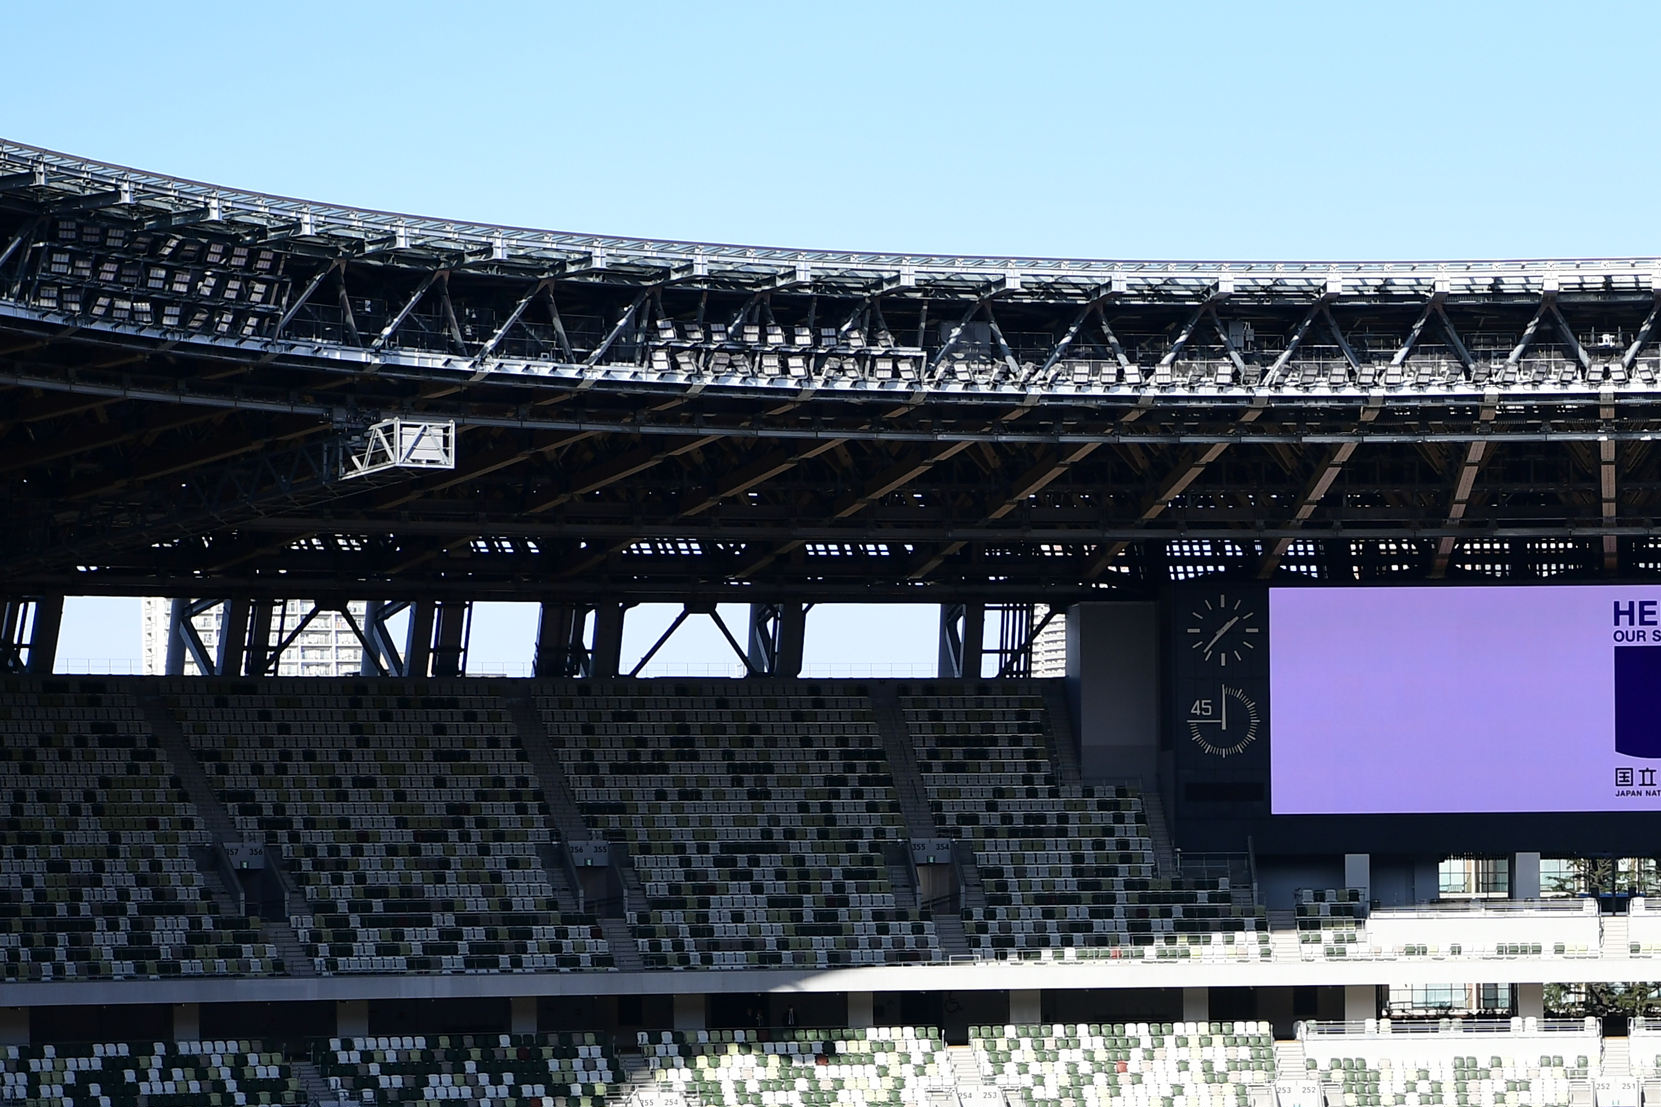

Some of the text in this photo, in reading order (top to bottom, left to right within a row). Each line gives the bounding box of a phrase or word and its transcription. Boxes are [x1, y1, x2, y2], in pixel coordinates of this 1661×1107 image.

[1613, 630, 1647, 643] OUR
[1190, 699, 1212, 716] 45
[1615, 789, 1642, 797] JAPAN
[248, 848, 263, 856] 356
[1302, 1086, 1317, 1094] 252
[1595, 1083, 1611, 1091] 252
[983, 1091, 998, 1099] 253
[664, 1099, 679, 1107] 254
